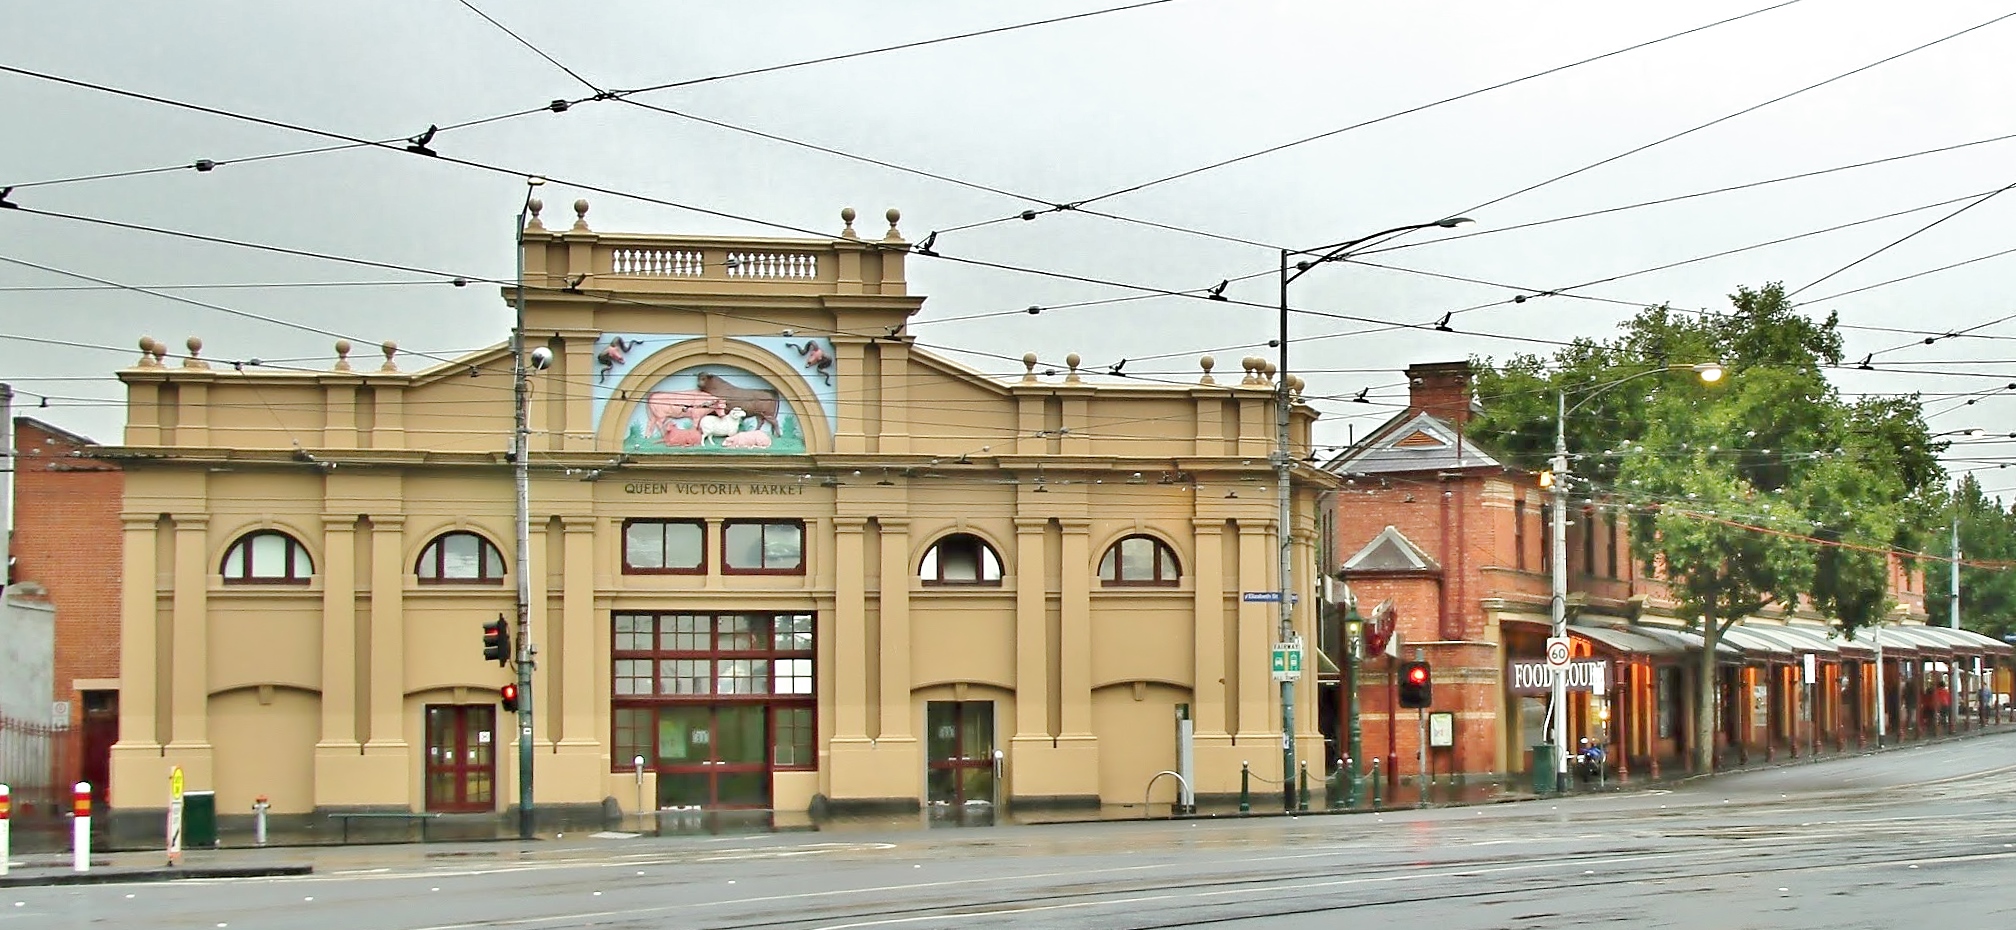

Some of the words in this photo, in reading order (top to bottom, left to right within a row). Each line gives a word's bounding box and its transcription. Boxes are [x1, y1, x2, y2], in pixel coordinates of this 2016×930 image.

[624, 484, 668, 495] QUEEN
[676, 484, 742, 496] VICTORIA
[750, 484, 804, 496] MARKET
[1552, 648, 1566, 660] 60
[1514, 664, 1552, 688] FOOD
